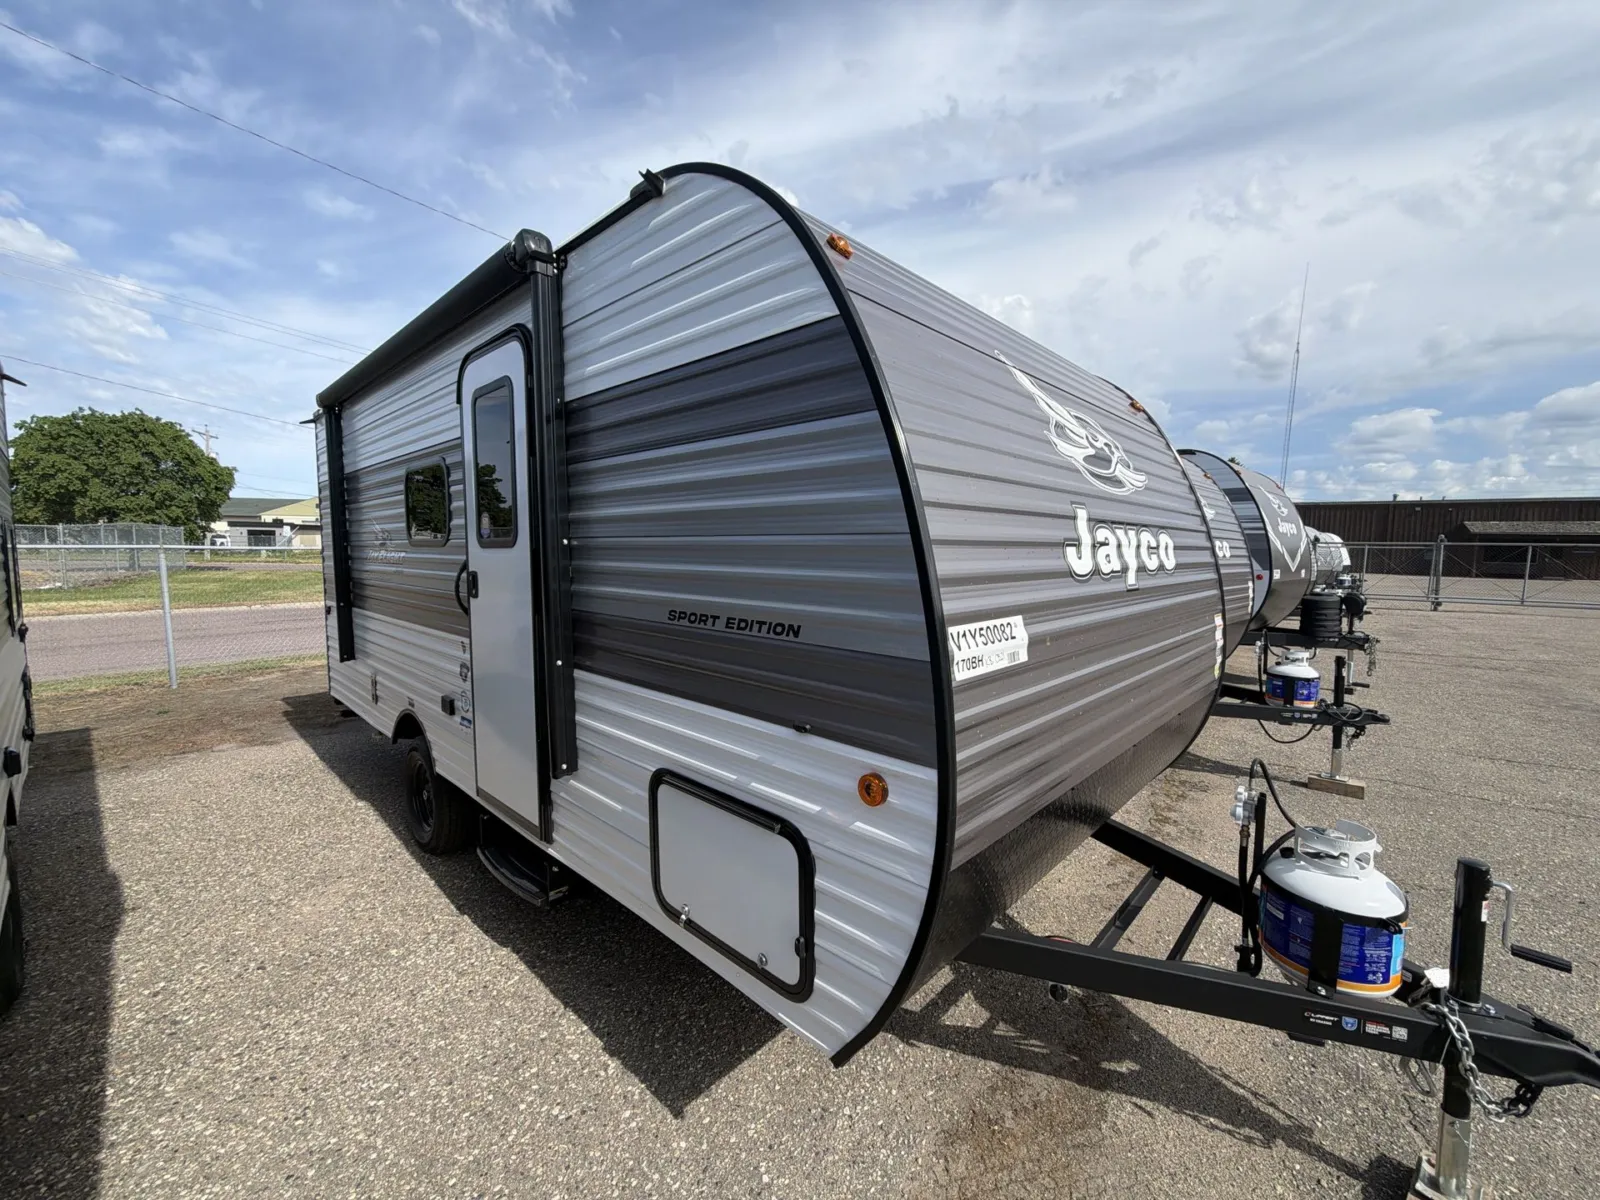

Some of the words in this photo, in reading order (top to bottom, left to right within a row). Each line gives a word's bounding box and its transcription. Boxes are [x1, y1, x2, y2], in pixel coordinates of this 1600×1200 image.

[1277, 517, 1297, 537] Jayco
[1064, 503, 1176, 590] Jayco
[667, 609, 721, 628] SPORT
[724, 616, 802, 639] EDITION
[950, 622, 1017, 652] V1Y50082
[955, 654, 984, 673] 170BH
